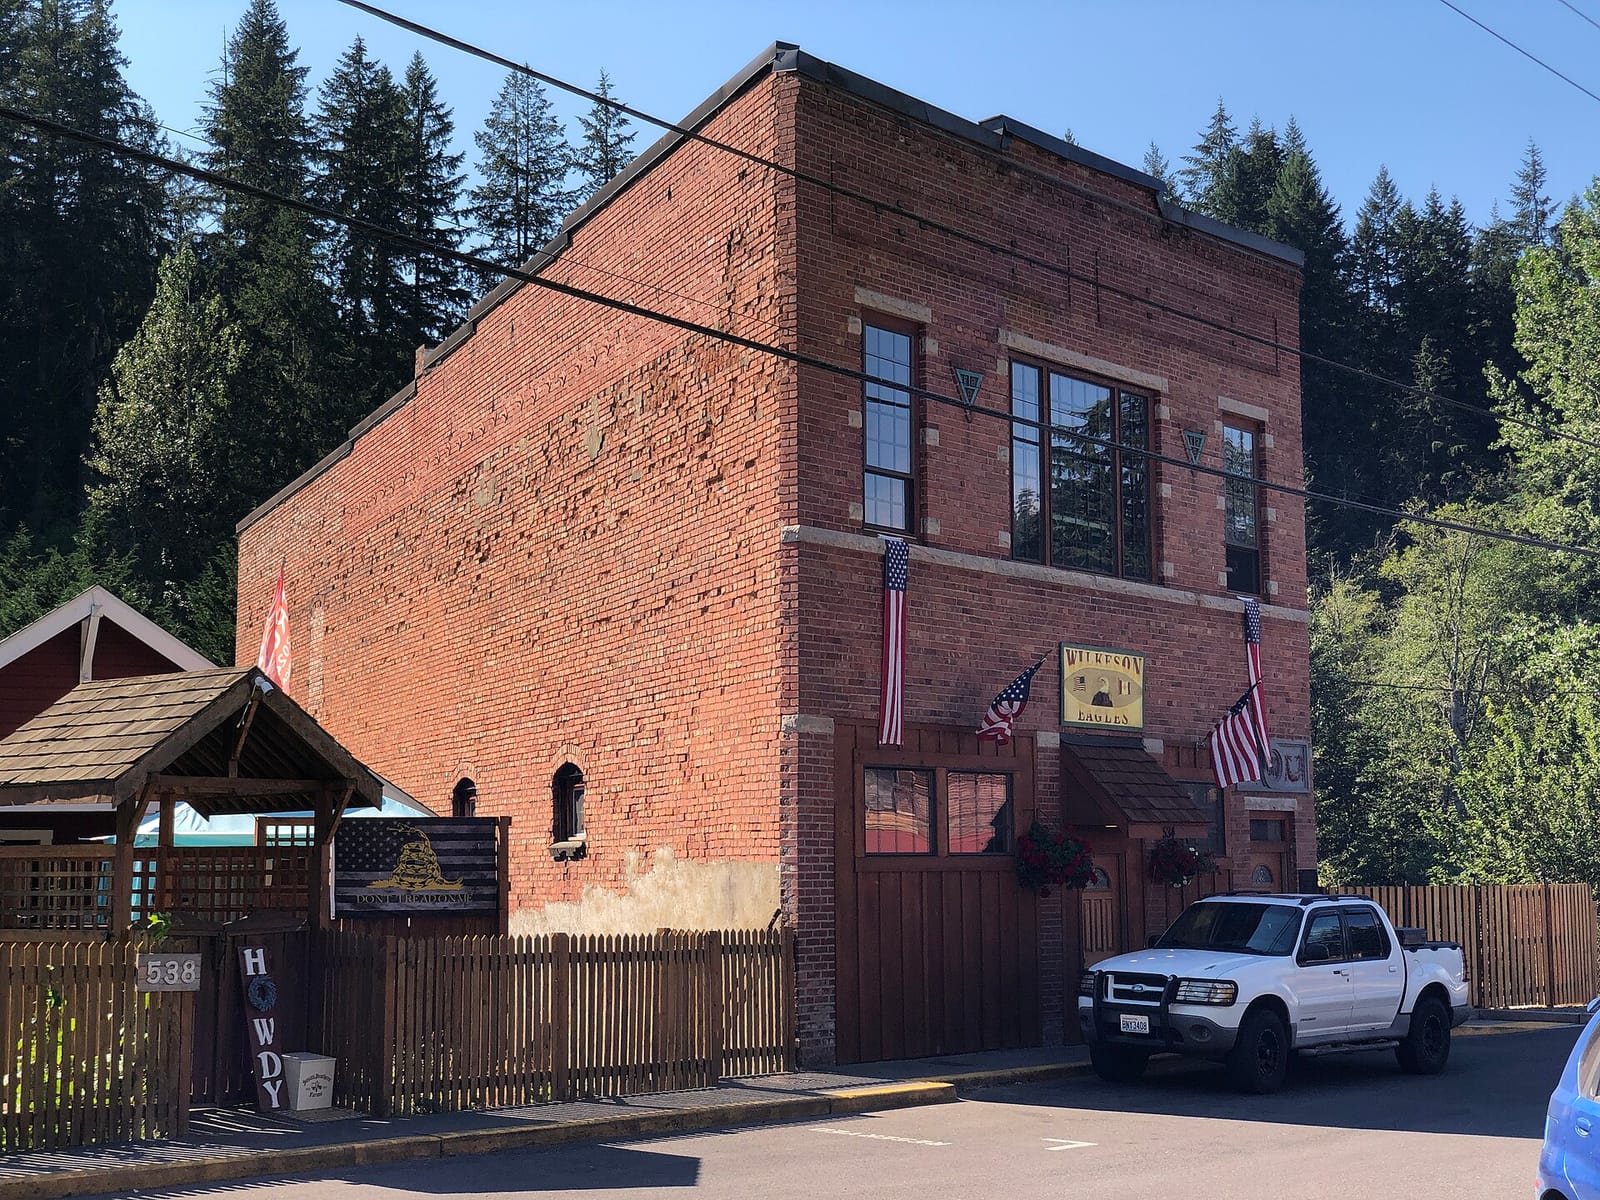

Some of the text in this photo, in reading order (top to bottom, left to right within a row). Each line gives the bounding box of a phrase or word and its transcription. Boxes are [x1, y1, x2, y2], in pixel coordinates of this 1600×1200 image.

[1065, 648, 1142, 675] WILKESON
[1078, 708, 1129, 725] EAGLES
[398, 894, 438, 904] TREAD
[146, 959, 196, 985] 538
